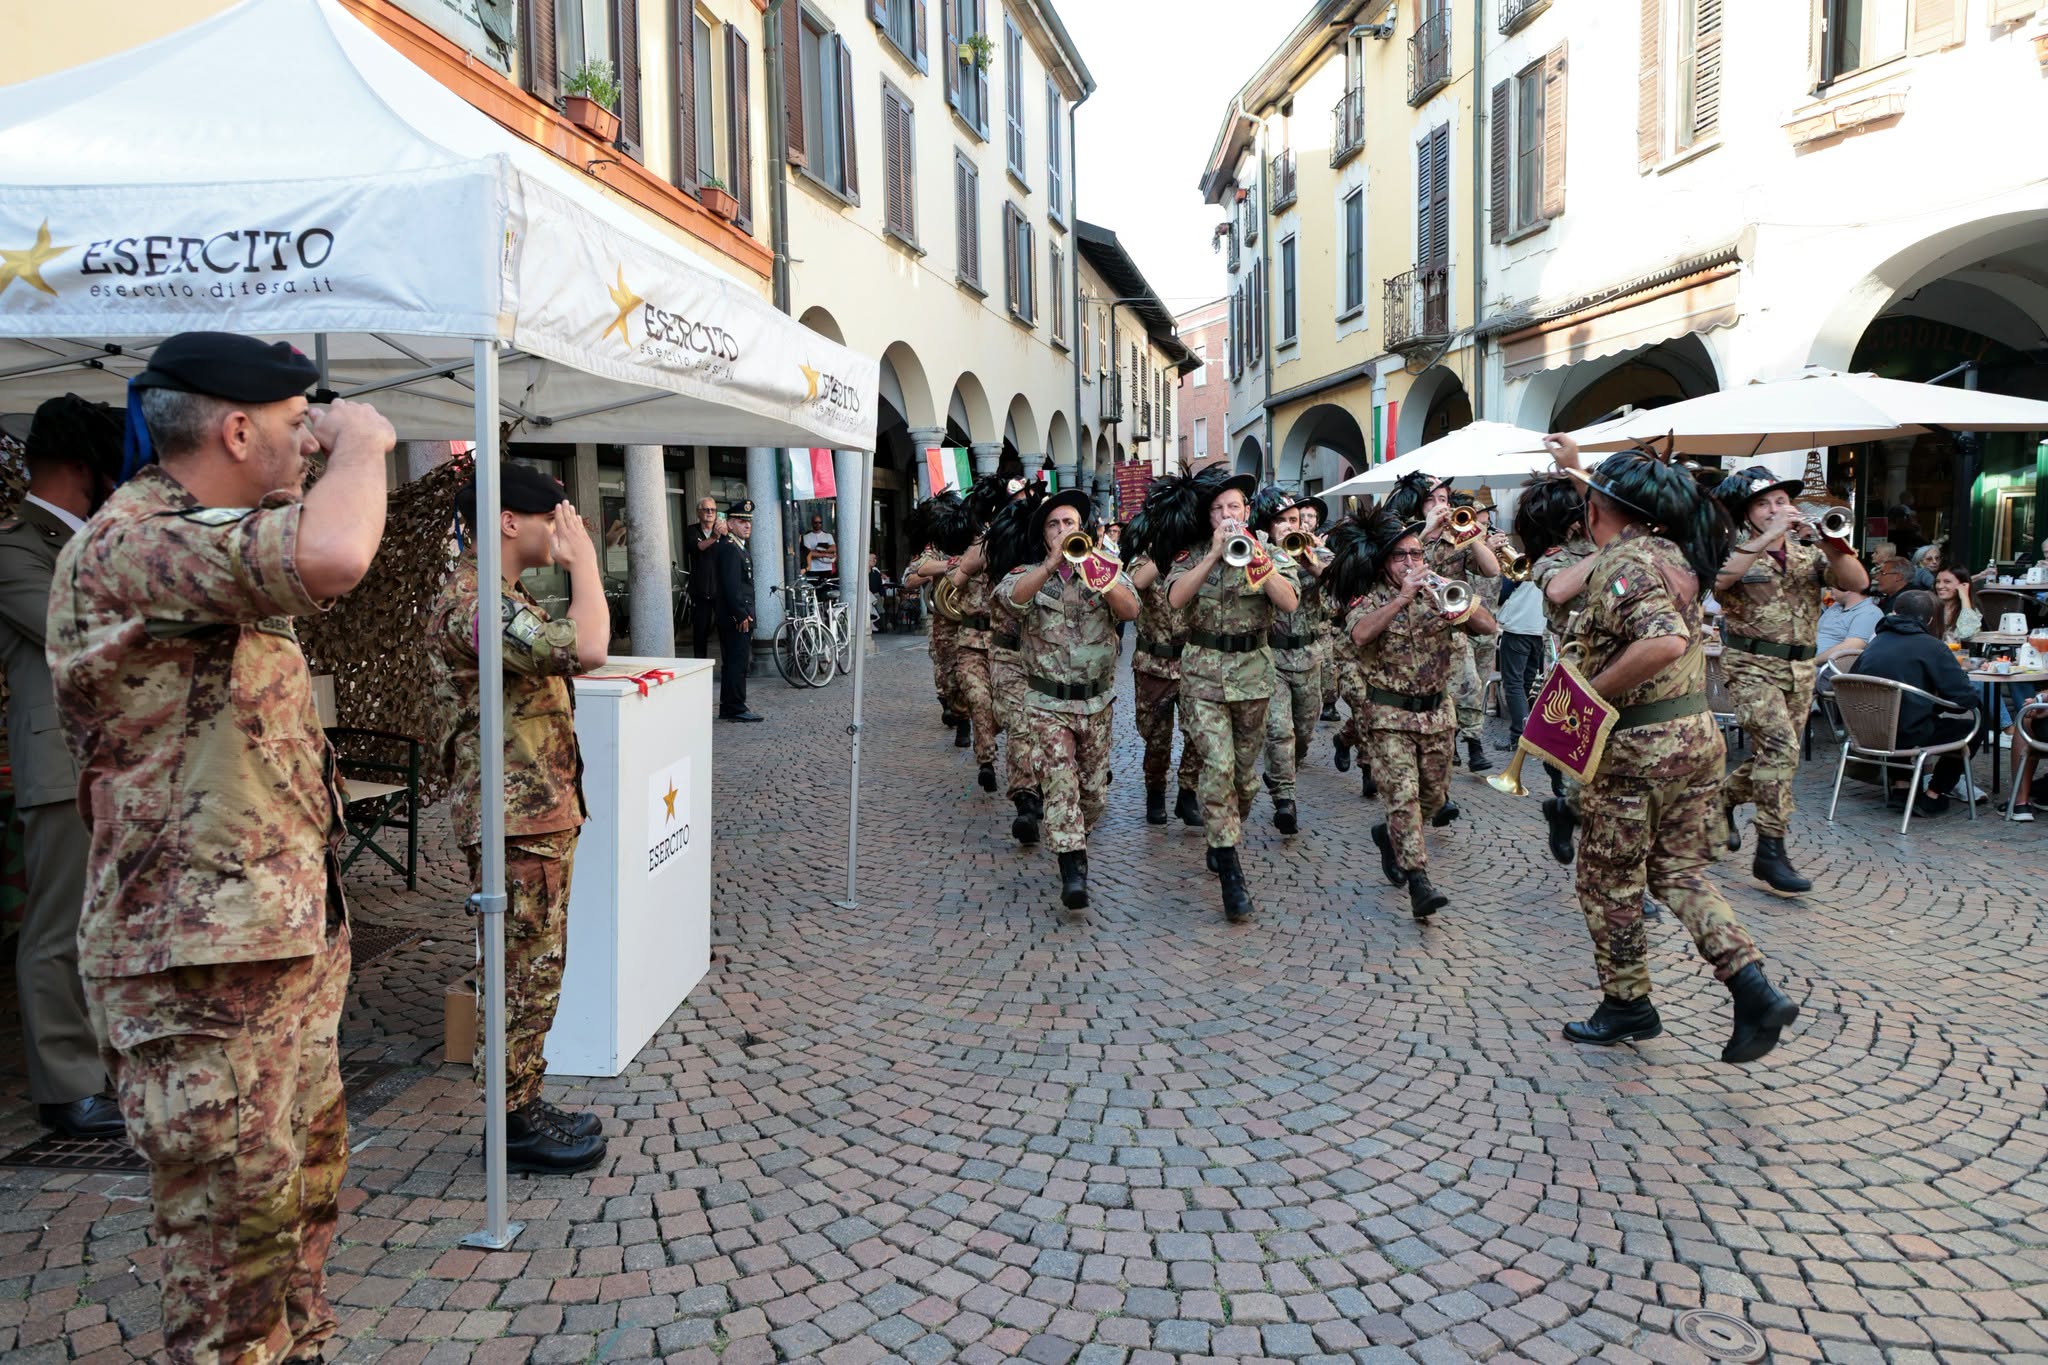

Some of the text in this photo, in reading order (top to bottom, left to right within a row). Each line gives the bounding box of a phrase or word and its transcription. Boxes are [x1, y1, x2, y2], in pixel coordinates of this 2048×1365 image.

[80, 228, 334, 277] ESERCITO
[90, 277, 333, 298] esercito.difesa.it
[644, 303, 738, 361] ESERCITO
[649, 824, 690, 871] ESERCITO
